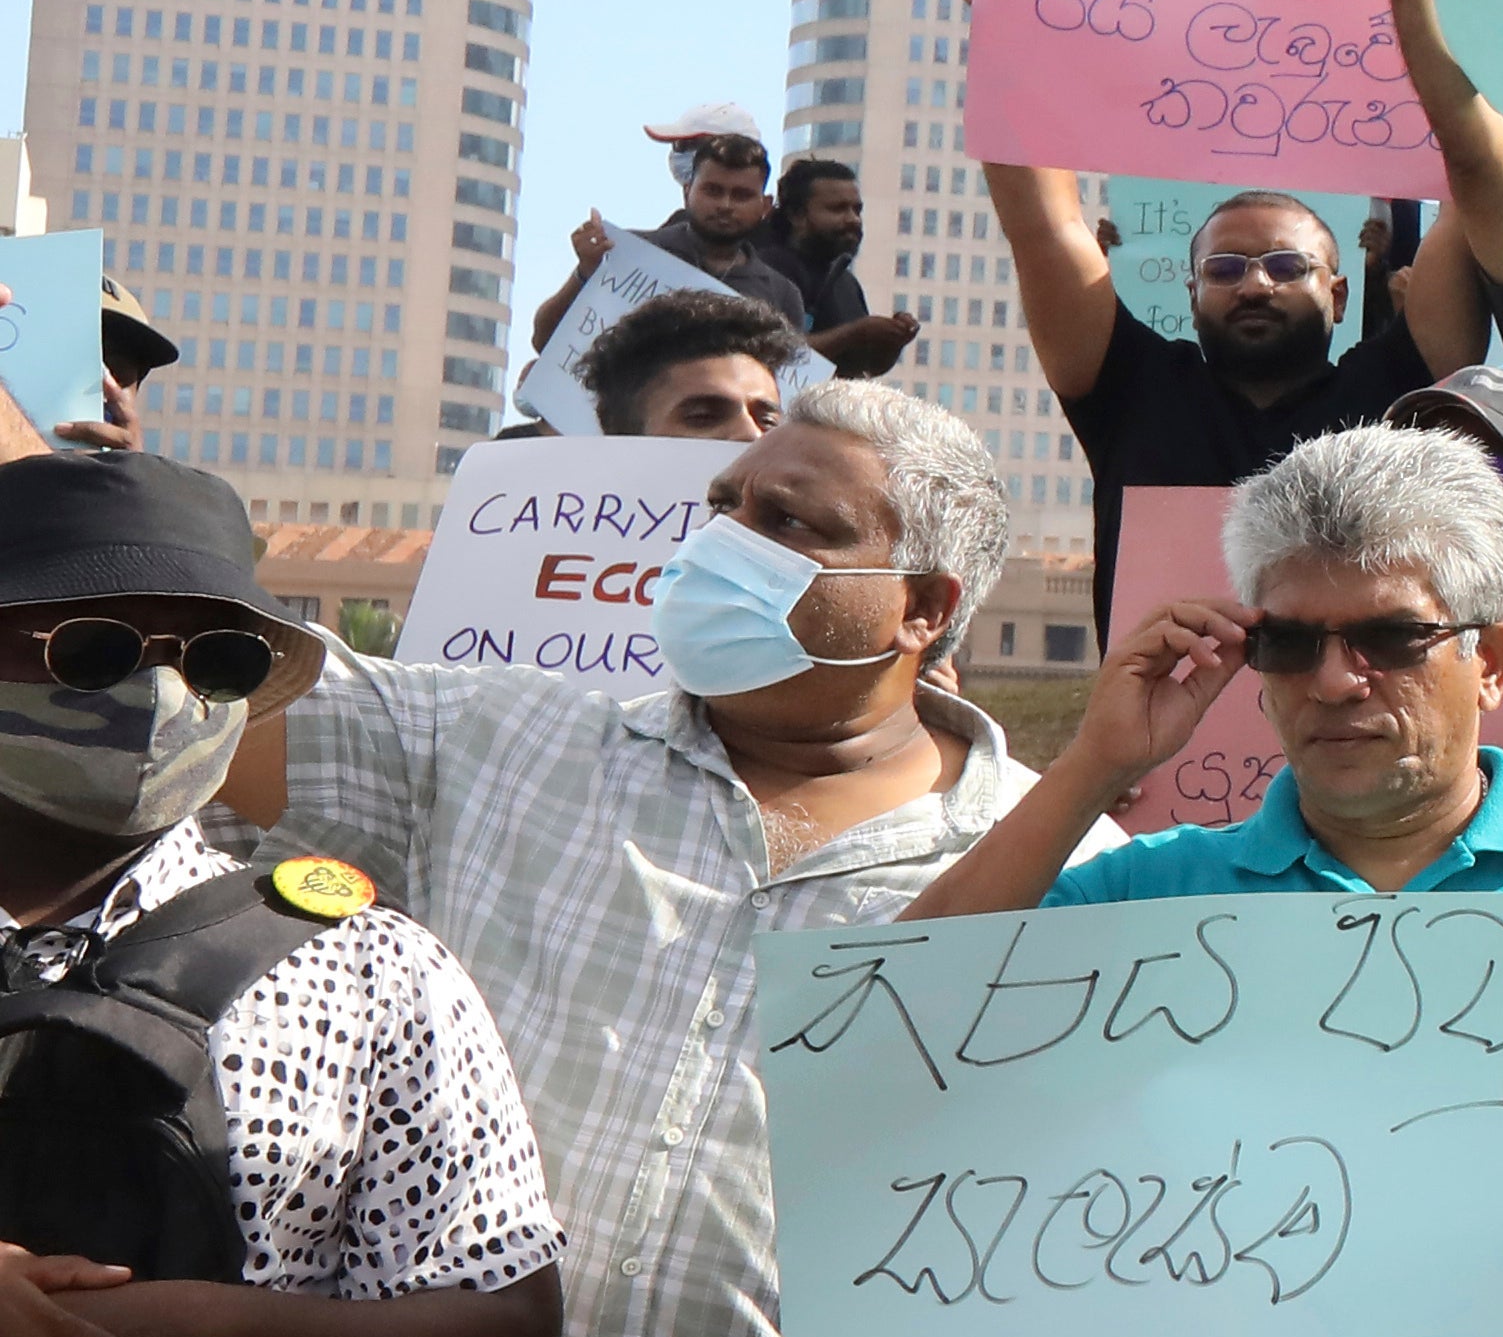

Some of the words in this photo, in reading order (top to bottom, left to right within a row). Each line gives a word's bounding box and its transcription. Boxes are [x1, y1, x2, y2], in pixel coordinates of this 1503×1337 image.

[469, 492, 700, 543] CARRYI
[443, 628, 514, 663] ON
[536, 633, 664, 677] OUR
